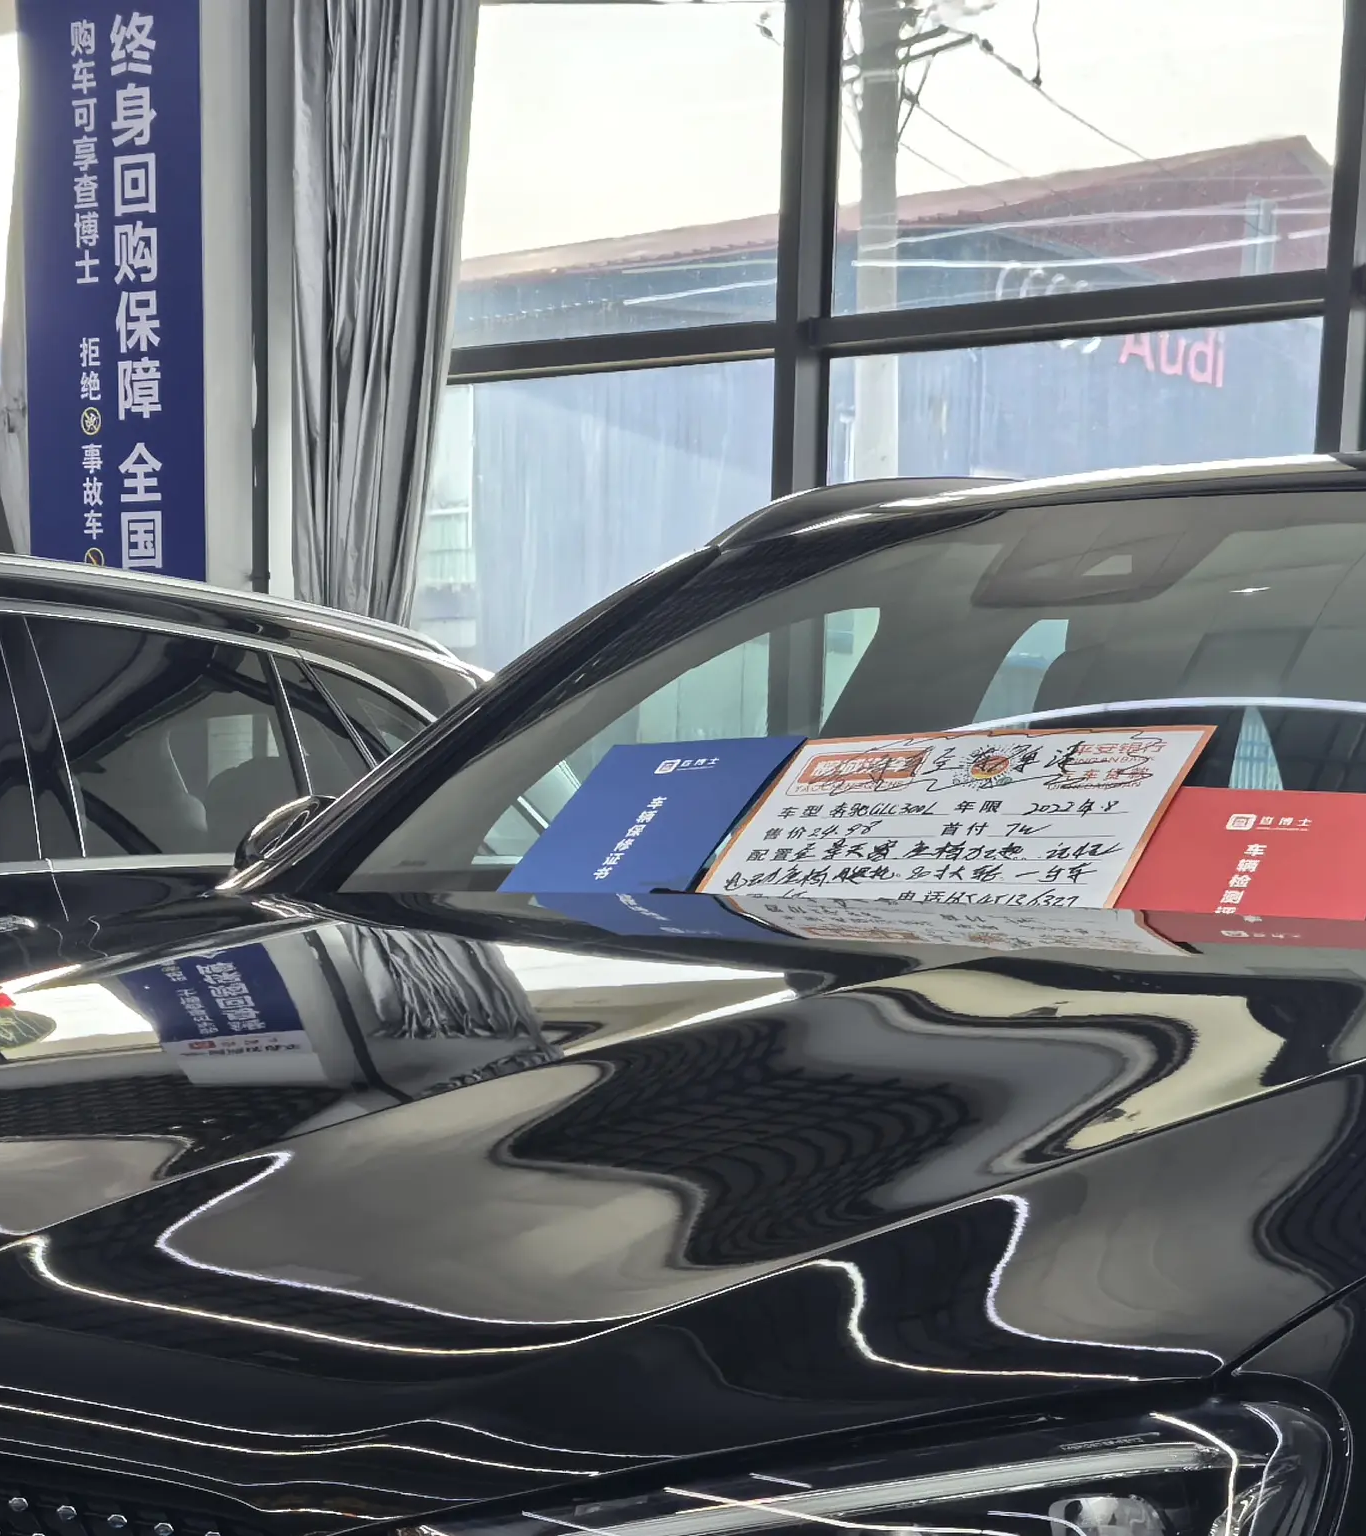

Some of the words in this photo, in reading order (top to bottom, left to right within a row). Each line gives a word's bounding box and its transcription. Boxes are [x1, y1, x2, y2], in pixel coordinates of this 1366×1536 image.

[69, 19, 100, 286] 购车可享查博士
[109, 12, 162, 421] 终身回购保障
[79, 337, 102, 402] 拒绝
[1119, 328, 1225, 388] Audi
[81, 443, 104, 540] 事故车
[117, 441, 164, 570] 全国
[954, 800, 1003, 814] 年限
